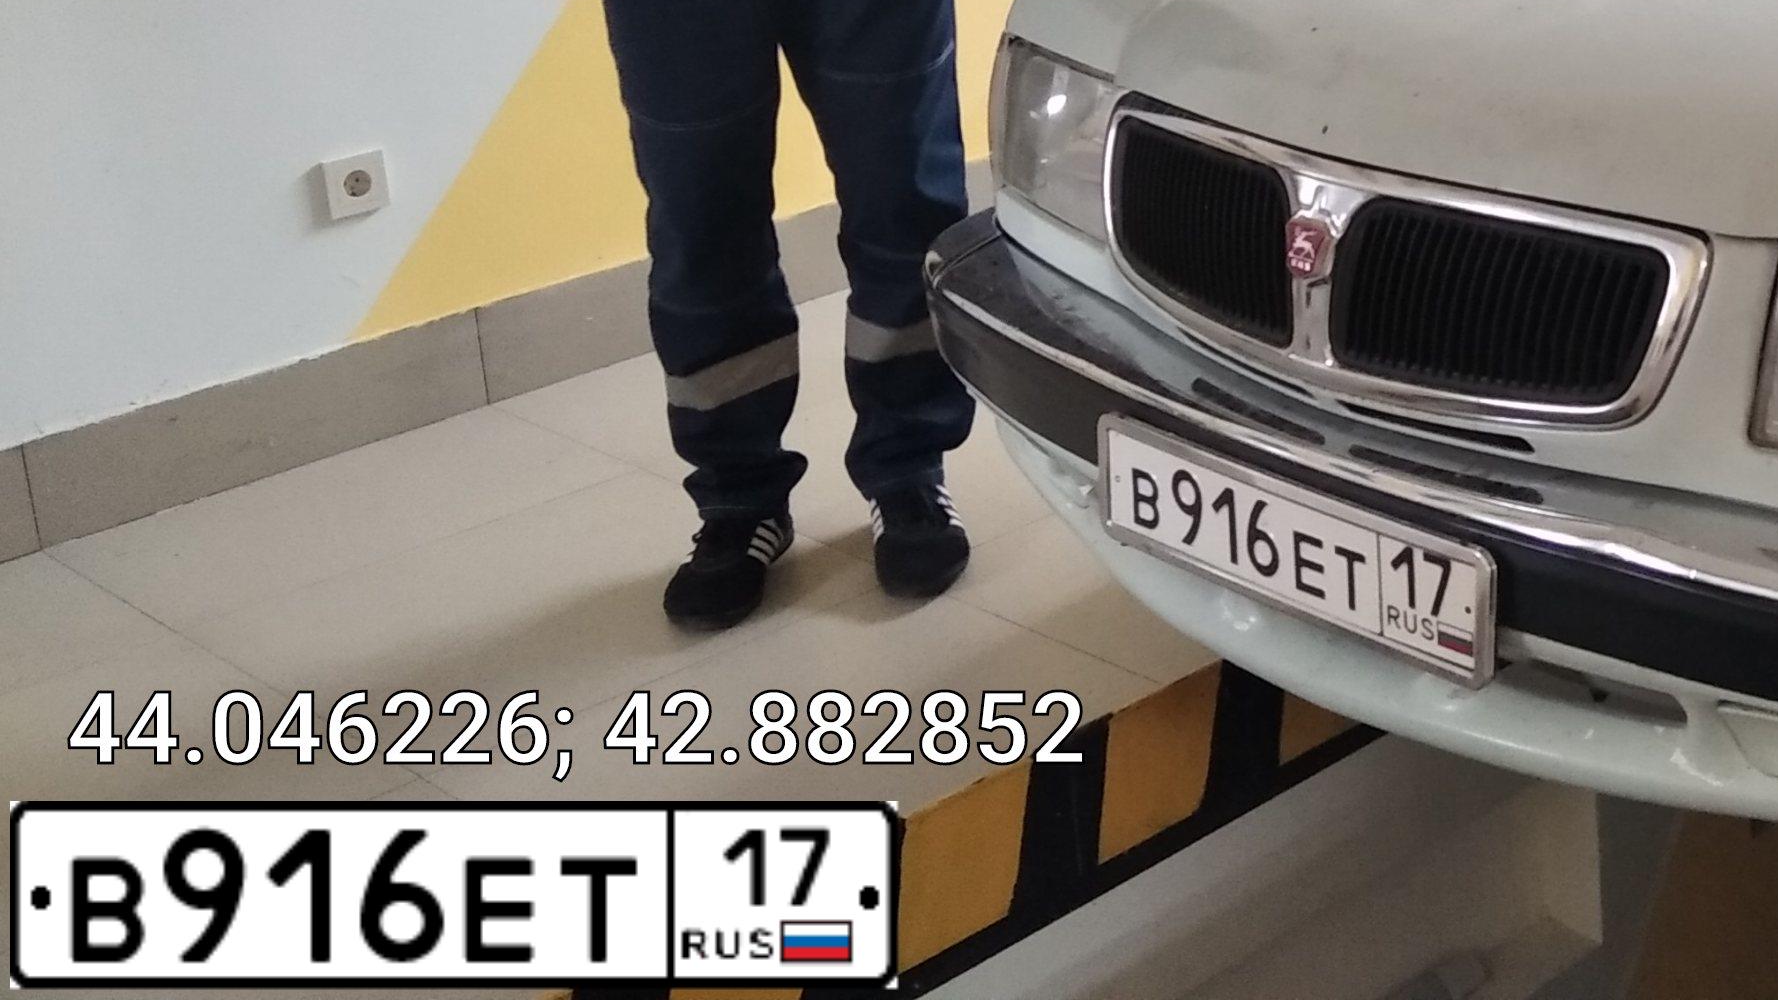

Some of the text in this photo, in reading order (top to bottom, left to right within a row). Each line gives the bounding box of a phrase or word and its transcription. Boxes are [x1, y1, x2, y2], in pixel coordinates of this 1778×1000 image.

[1131, 466, 1452, 617] В916ЕТ 17
[1386, 603, 1435, 642] RUS
